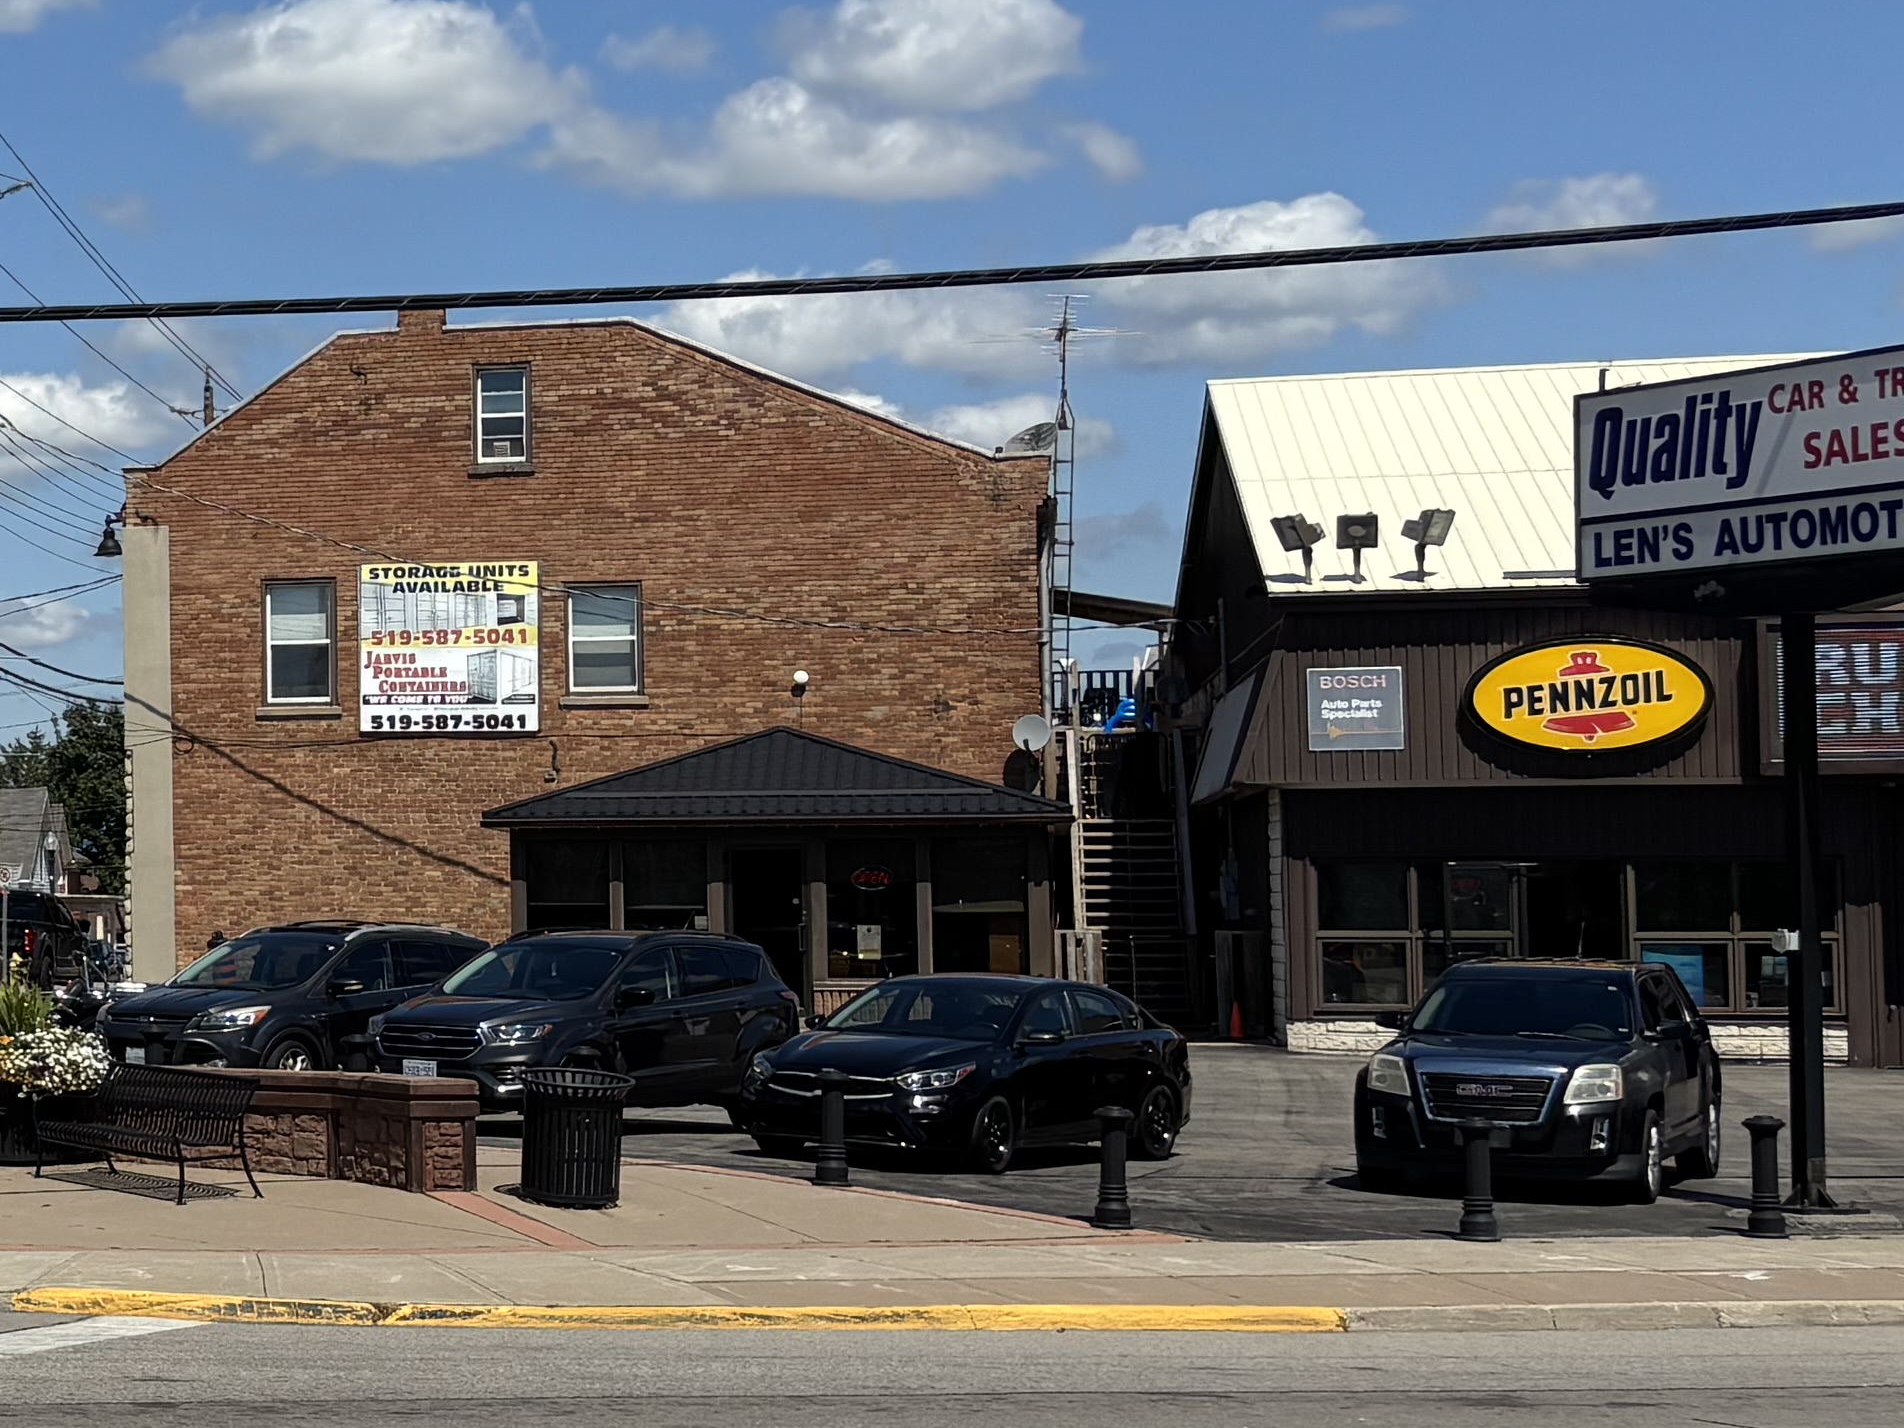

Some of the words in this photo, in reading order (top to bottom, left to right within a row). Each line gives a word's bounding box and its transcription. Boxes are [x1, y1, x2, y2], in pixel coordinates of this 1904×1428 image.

[1767, 379, 1824, 414] CAR
[1838, 373, 1859, 404] &
[1589, 389, 1763, 500] Quality
[1593, 522, 1694, 569] LEN'S
[369, 566, 461, 579] STORAGE
[468, 564, 530, 578] UNITS
[392, 579, 504, 594] AVAILABLE
[371, 628, 527, 646] 519-587-5041
[364, 651, 417, 669] JARVIS
[372, 666, 448, 679] PORTABLE
[378, 680, 467, 694] CONTAINERS
[1319, 675, 1387, 689] BOSCH
[391, 696, 423, 704] COME
[427, 696, 441, 704] TO
[1502, 669, 1673, 720] PENNZOIL
[1321, 699, 1349, 709] Auto
[1351, 698, 1383, 709] Parts
[371, 714, 527, 730] 519-587-5041
[1320, 709, 1379, 720] Specialist
[1456, 1083, 1513, 1098] GMC
